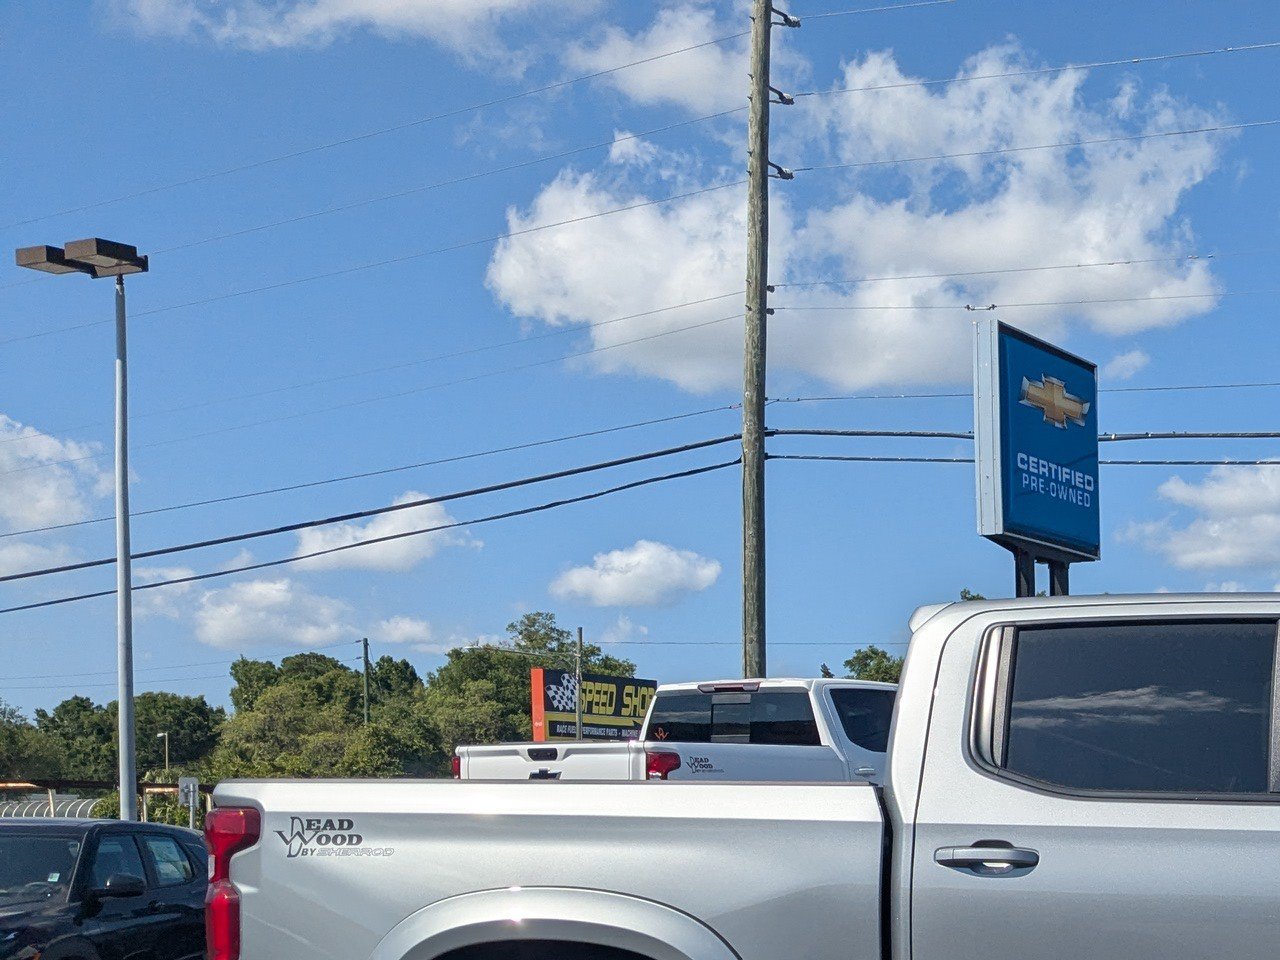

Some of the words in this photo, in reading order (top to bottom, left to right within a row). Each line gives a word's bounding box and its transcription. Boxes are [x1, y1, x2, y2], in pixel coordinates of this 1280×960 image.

[1017, 452, 1094, 492] CERTIFIED
[1022, 473, 1091, 508] PRE-OWNED
[580, 681, 617, 715] SPEED
[273, 830, 363, 846] WOOD
[289, 816, 354, 837] DEAD
[301, 848, 316, 856] BY
[316, 847, 395, 857] SHERROD
